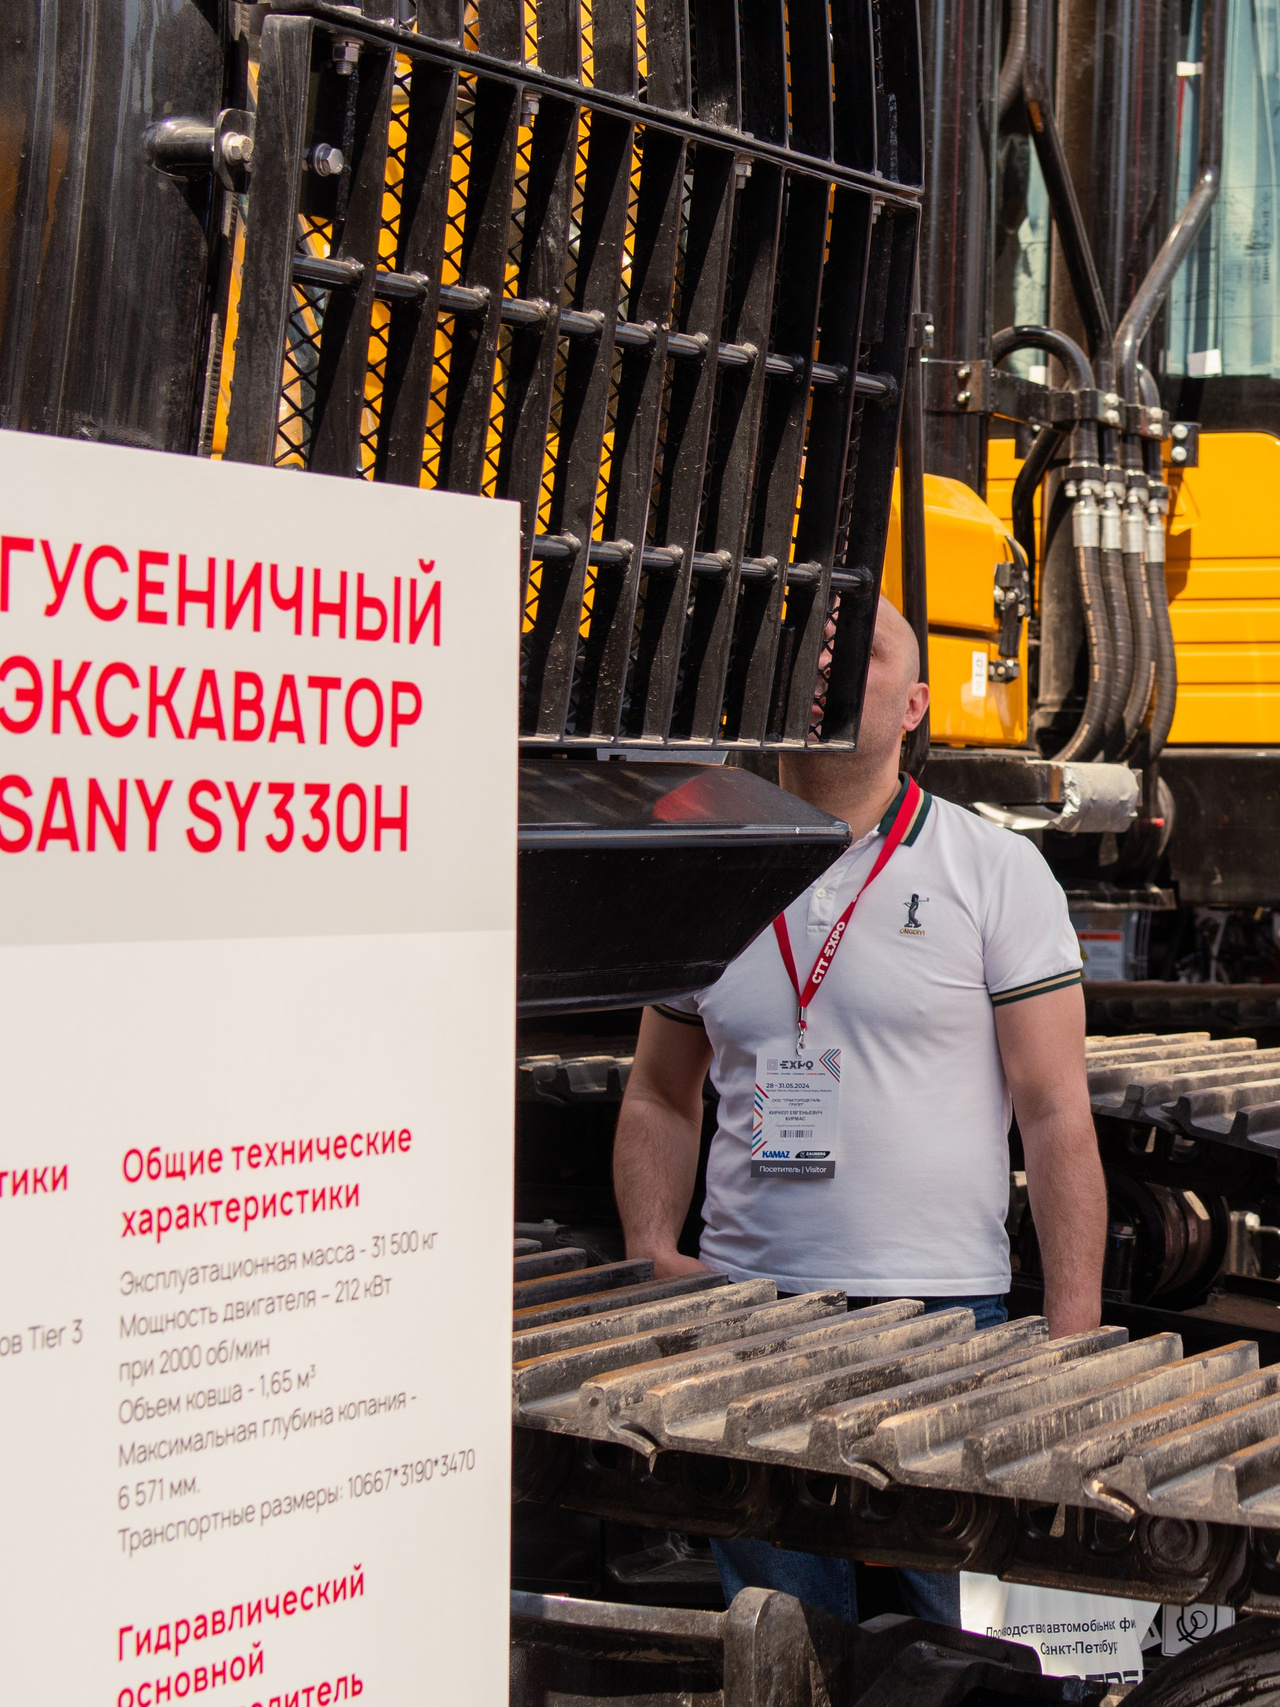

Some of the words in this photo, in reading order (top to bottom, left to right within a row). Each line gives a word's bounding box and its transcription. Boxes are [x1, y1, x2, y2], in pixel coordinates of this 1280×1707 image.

[0, 535, 442, 647] ГУСЕНИЧНЫЙ
[0, 655, 422, 748] ЭКСКАВАТОР
[0, 774, 174, 854] SANY
[185, 779, 409, 854] SY330H
[811, 958, 829, 984] CTT
[823, 921, 846, 957] EXPO
[779, 1060, 814, 1071] EXPO
[123, 1146, 223, 1183] Общие
[231, 1128, 412, 1171] технические
[762, 1151, 790, 1159] KAMAZ
[805, 1165, 827, 1173] Visitor
[121, 1183, 360, 1244] характеристики
[120, 1252, 297, 1295] Эксплуатационная
[302, 1244, 355, 1268] масса
[371, 1235, 386, 1258] 31
[390, 1230, 418, 1255] 500
[422, 1231, 438, 1251] кг
[28, 1325, 67, 1351] Tier
[72, 1318, 83, 1344] 3
[120, 1305, 218, 1339] Мощность
[223, 1289, 316, 1323] двигателя
[335, 1278, 360, 1303] 212
[364, 1274, 392, 1299] кВт
[119, 1358, 154, 1387] при
[160, 1344, 202, 1374] 2000
[206, 1338, 270, 1366] об/мин
[186, 1384, 242, 1411] ковша
[260, 1369, 292, 1399] 1,65
[119, 1422, 257, 1468] Максимальная
[262, 1408, 334, 1440] глубина
[338, 1392, 406, 1423] копания
[118, 1485, 130, 1510] 6
[135, 1478, 164, 1506] 571
[169, 1477, 200, 1499] мм.
[118, 1504, 256, 1558] Транспортные
[260, 1485, 343, 1526] размеры:
[118, 1563, 365, 1662] Гидравлический
[117, 1640, 264, 1707] основной
